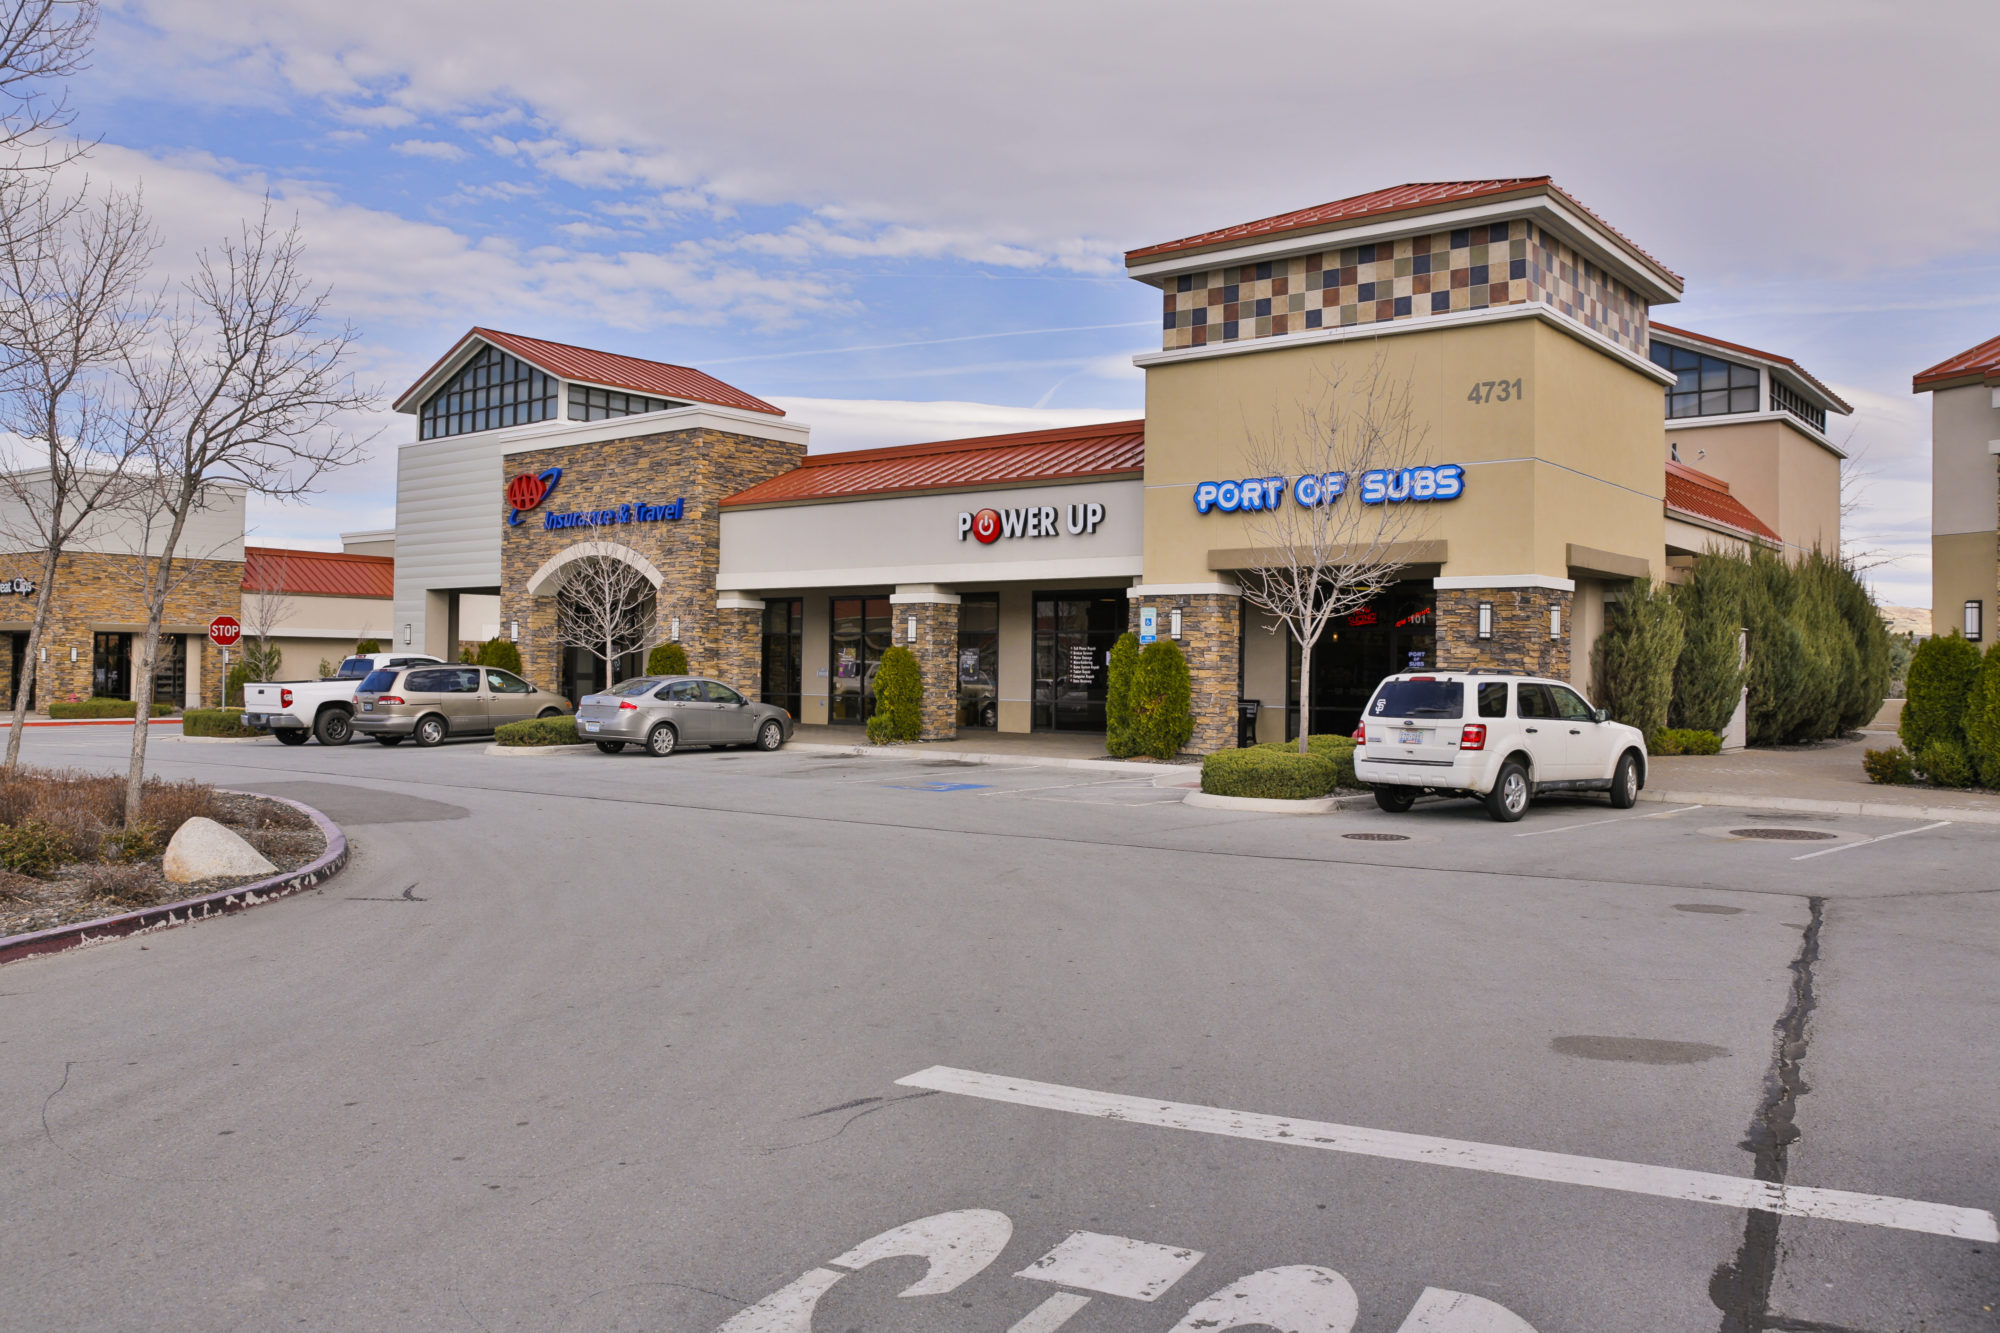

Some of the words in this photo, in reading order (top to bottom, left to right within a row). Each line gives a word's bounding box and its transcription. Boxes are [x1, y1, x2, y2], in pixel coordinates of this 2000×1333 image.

[1467, 377, 1522, 404] 4731
[511, 475, 541, 508] AAA
[1195, 477, 1286, 512] PORT
[1295, 473, 1347, 506] OF
[1362, 465, 1465, 503] SUBS
[544, 511, 616, 530] Insurance
[618, 503, 631, 524] &
[633, 497, 685, 522] Travel
[958, 507, 1058, 543] POWER
[1067, 503, 1104, 535] UP
[211, 625, 239, 637] STOP
[1411, 615, 1426, 624] 101
